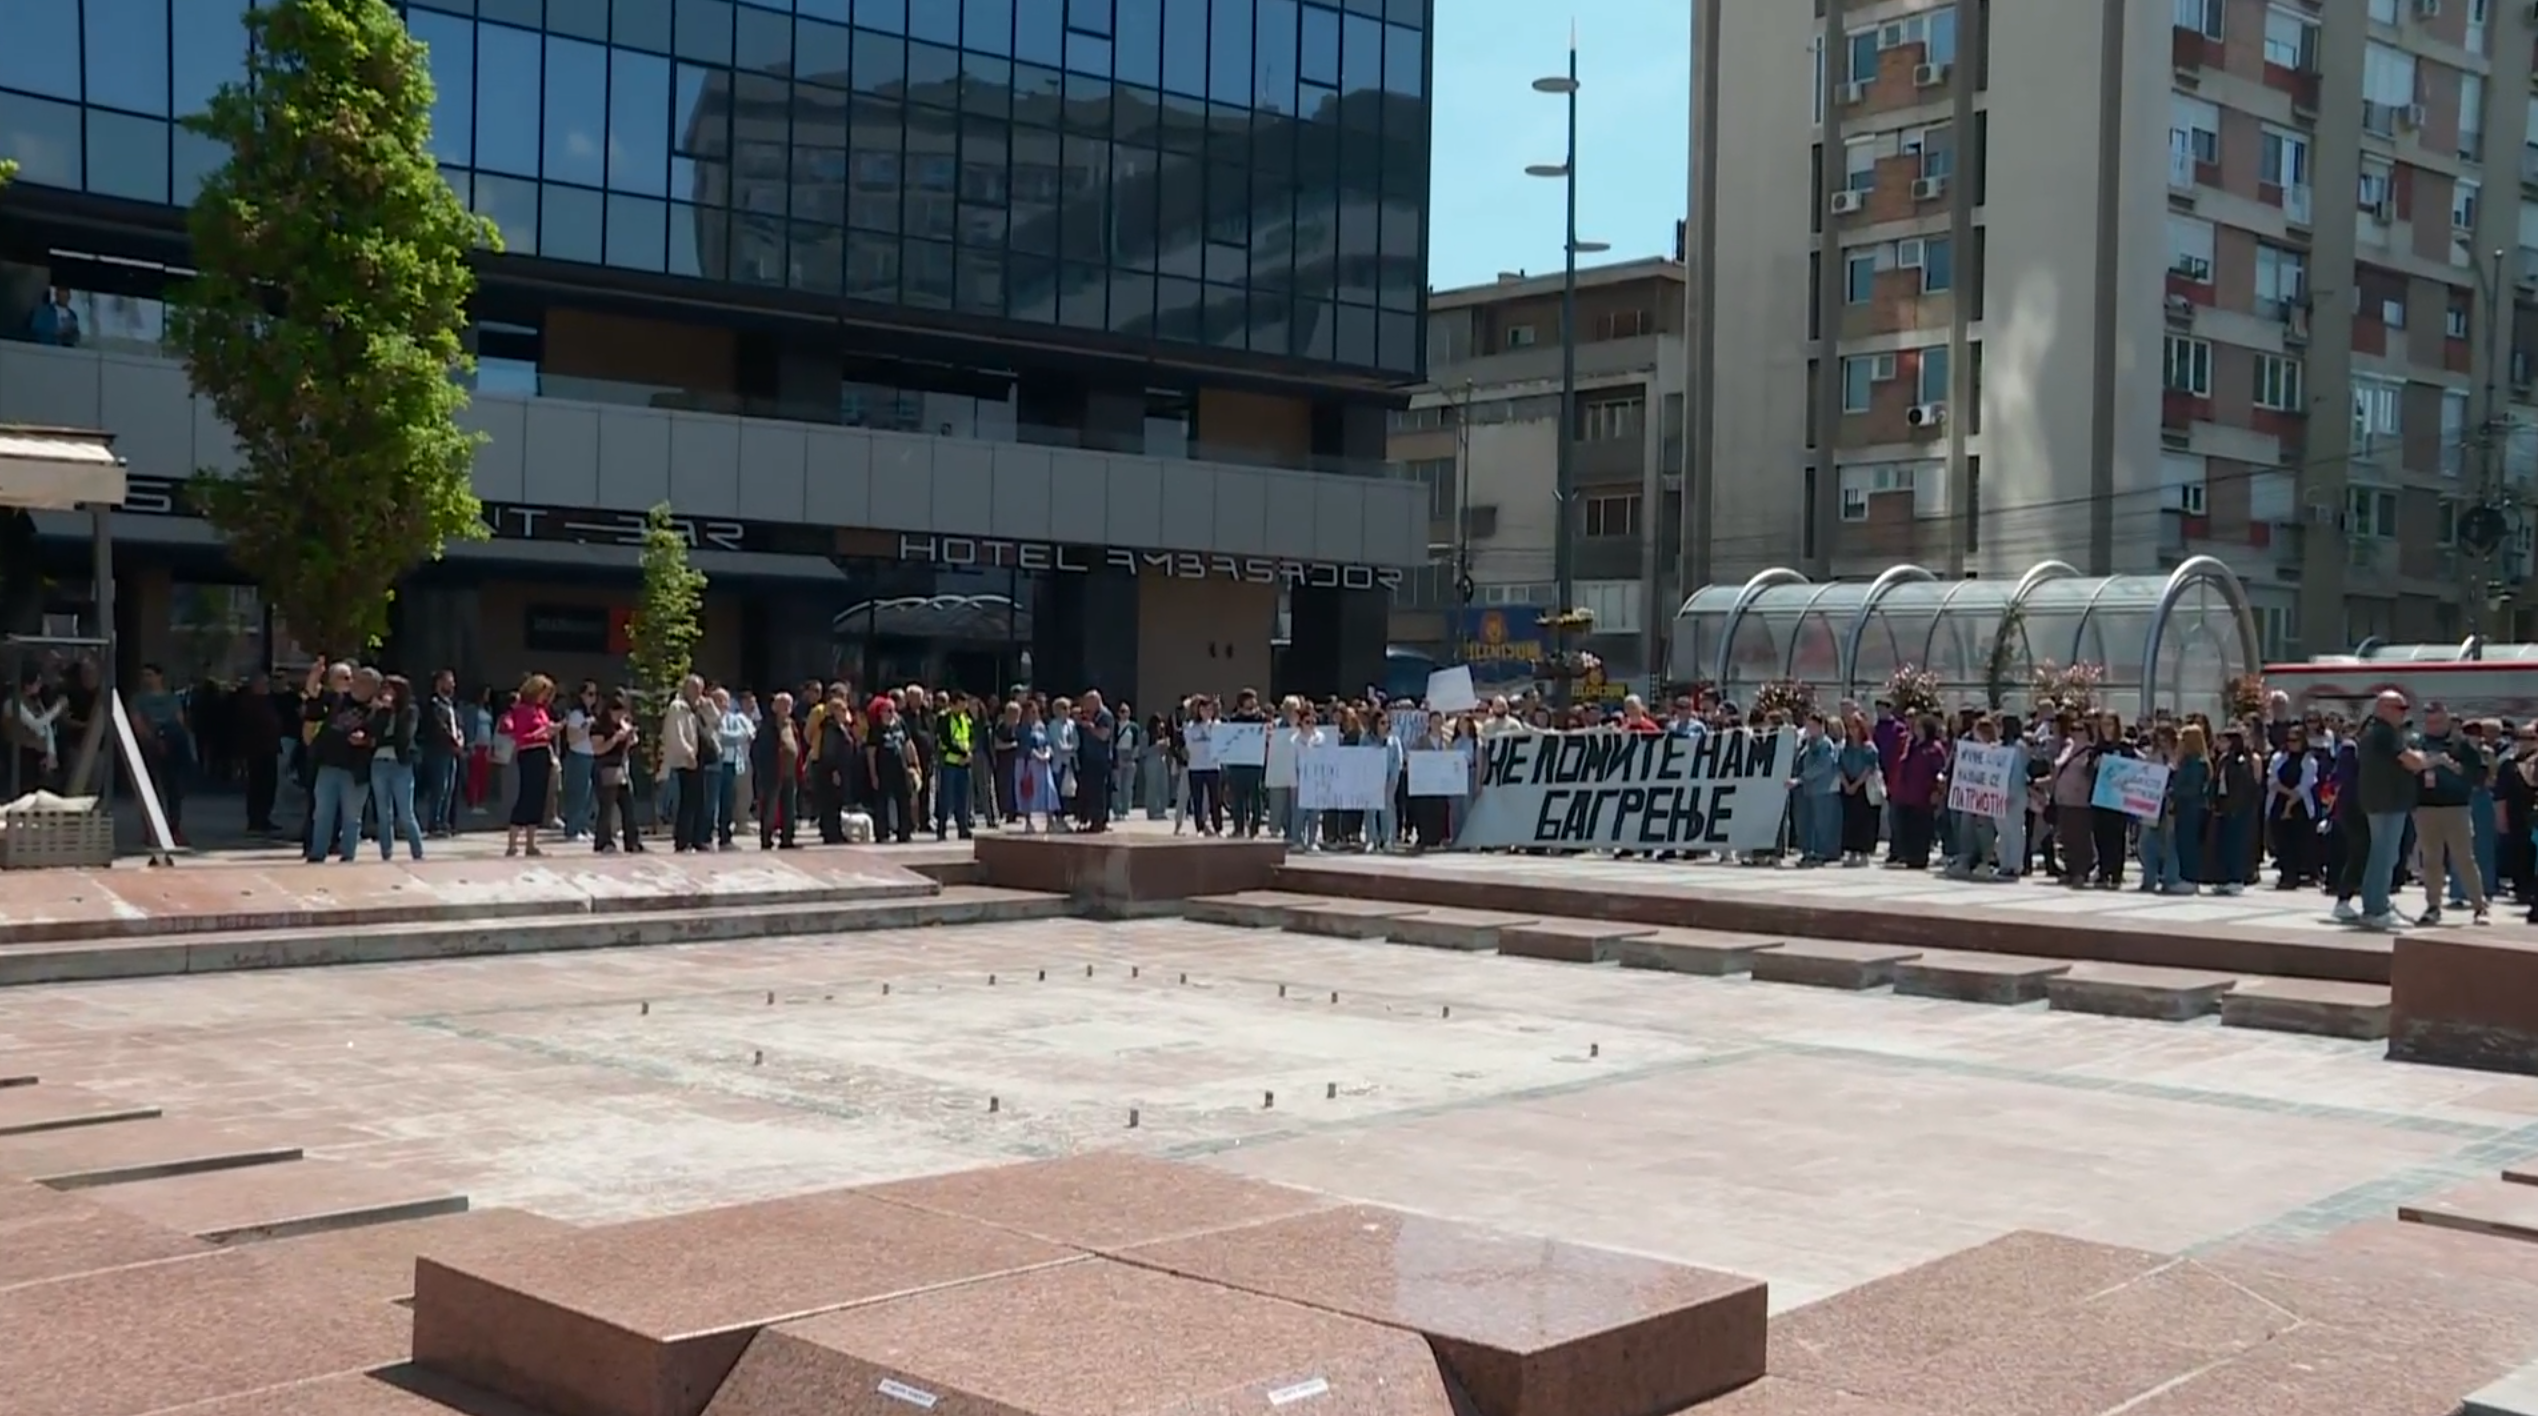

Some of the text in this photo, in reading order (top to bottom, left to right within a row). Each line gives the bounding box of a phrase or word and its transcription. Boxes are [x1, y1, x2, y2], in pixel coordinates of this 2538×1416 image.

[899, 533, 1403, 591] HOTEL AMBASADOR
[1483, 729, 1778, 787] НЕ ЛОМИТЕ НАМ
[1533, 785, 1737, 843] БАГРЕЊЕ
